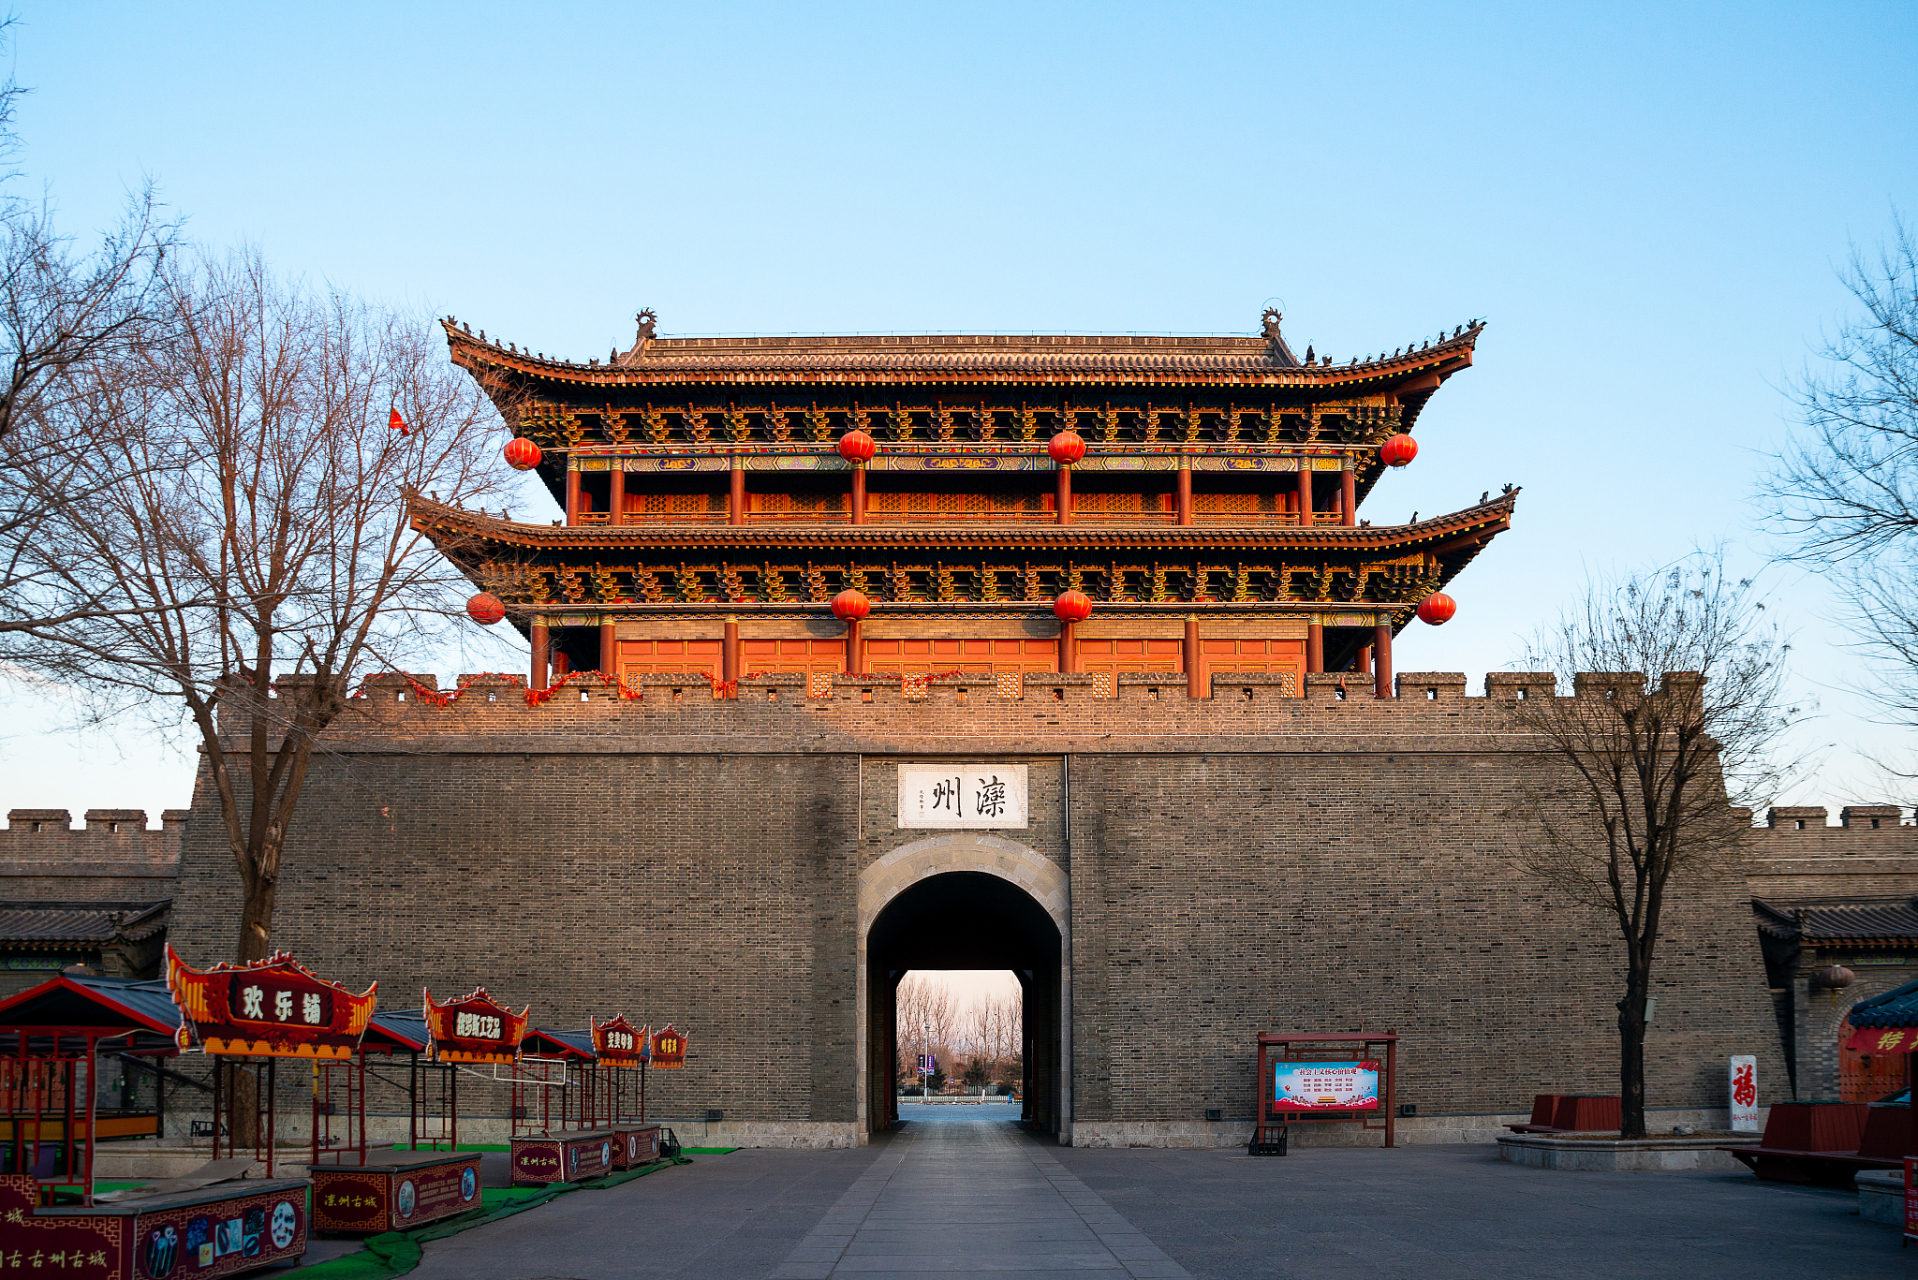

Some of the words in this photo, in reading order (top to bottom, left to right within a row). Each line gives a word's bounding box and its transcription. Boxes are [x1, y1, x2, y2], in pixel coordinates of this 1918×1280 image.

[243, 984, 321, 1025] 欢乐铺
[456, 1011, 501, 1039] 俄罗斯工艺品
[1299, 1068, 1358, 1076] 社会主义核心价值观
[1732, 1064, 1756, 1108] 福
